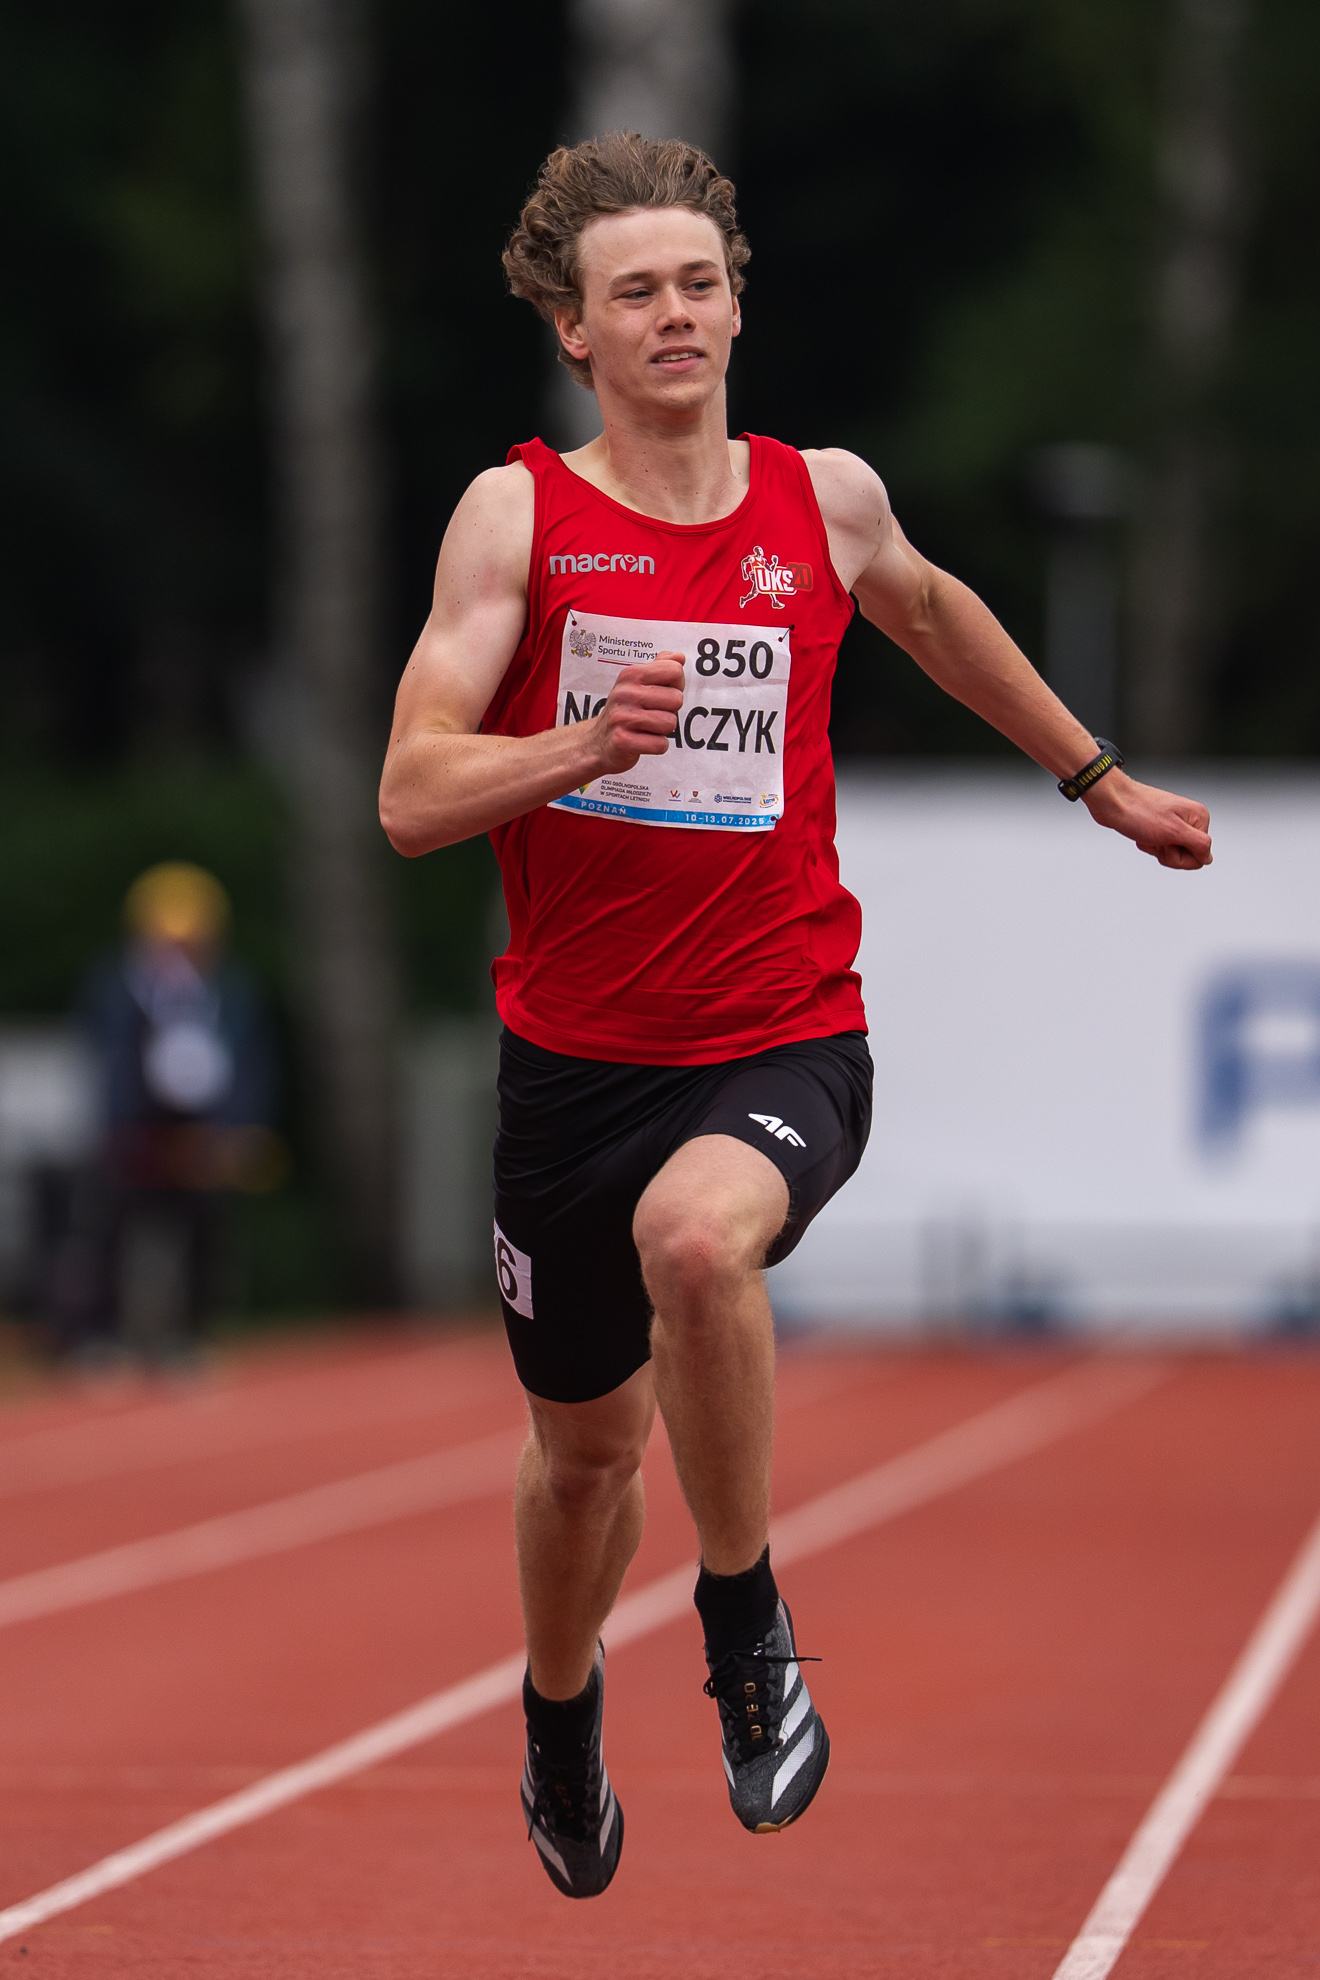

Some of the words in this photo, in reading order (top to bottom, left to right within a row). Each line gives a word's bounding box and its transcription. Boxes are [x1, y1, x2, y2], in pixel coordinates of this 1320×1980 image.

[549, 553, 655, 575] macron
[756, 568, 794, 592] UKS
[599, 635, 654, 649] Ministerstwo
[598, 645, 626, 657] Sportu
[633, 649, 658, 660] Turyst
[695, 638, 774, 679] 850
[581, 801, 627, 815] POZNAŃ
[685, 813, 765, 825] 10-13.07.2025
[499, 1237, 518, 1301] 6
